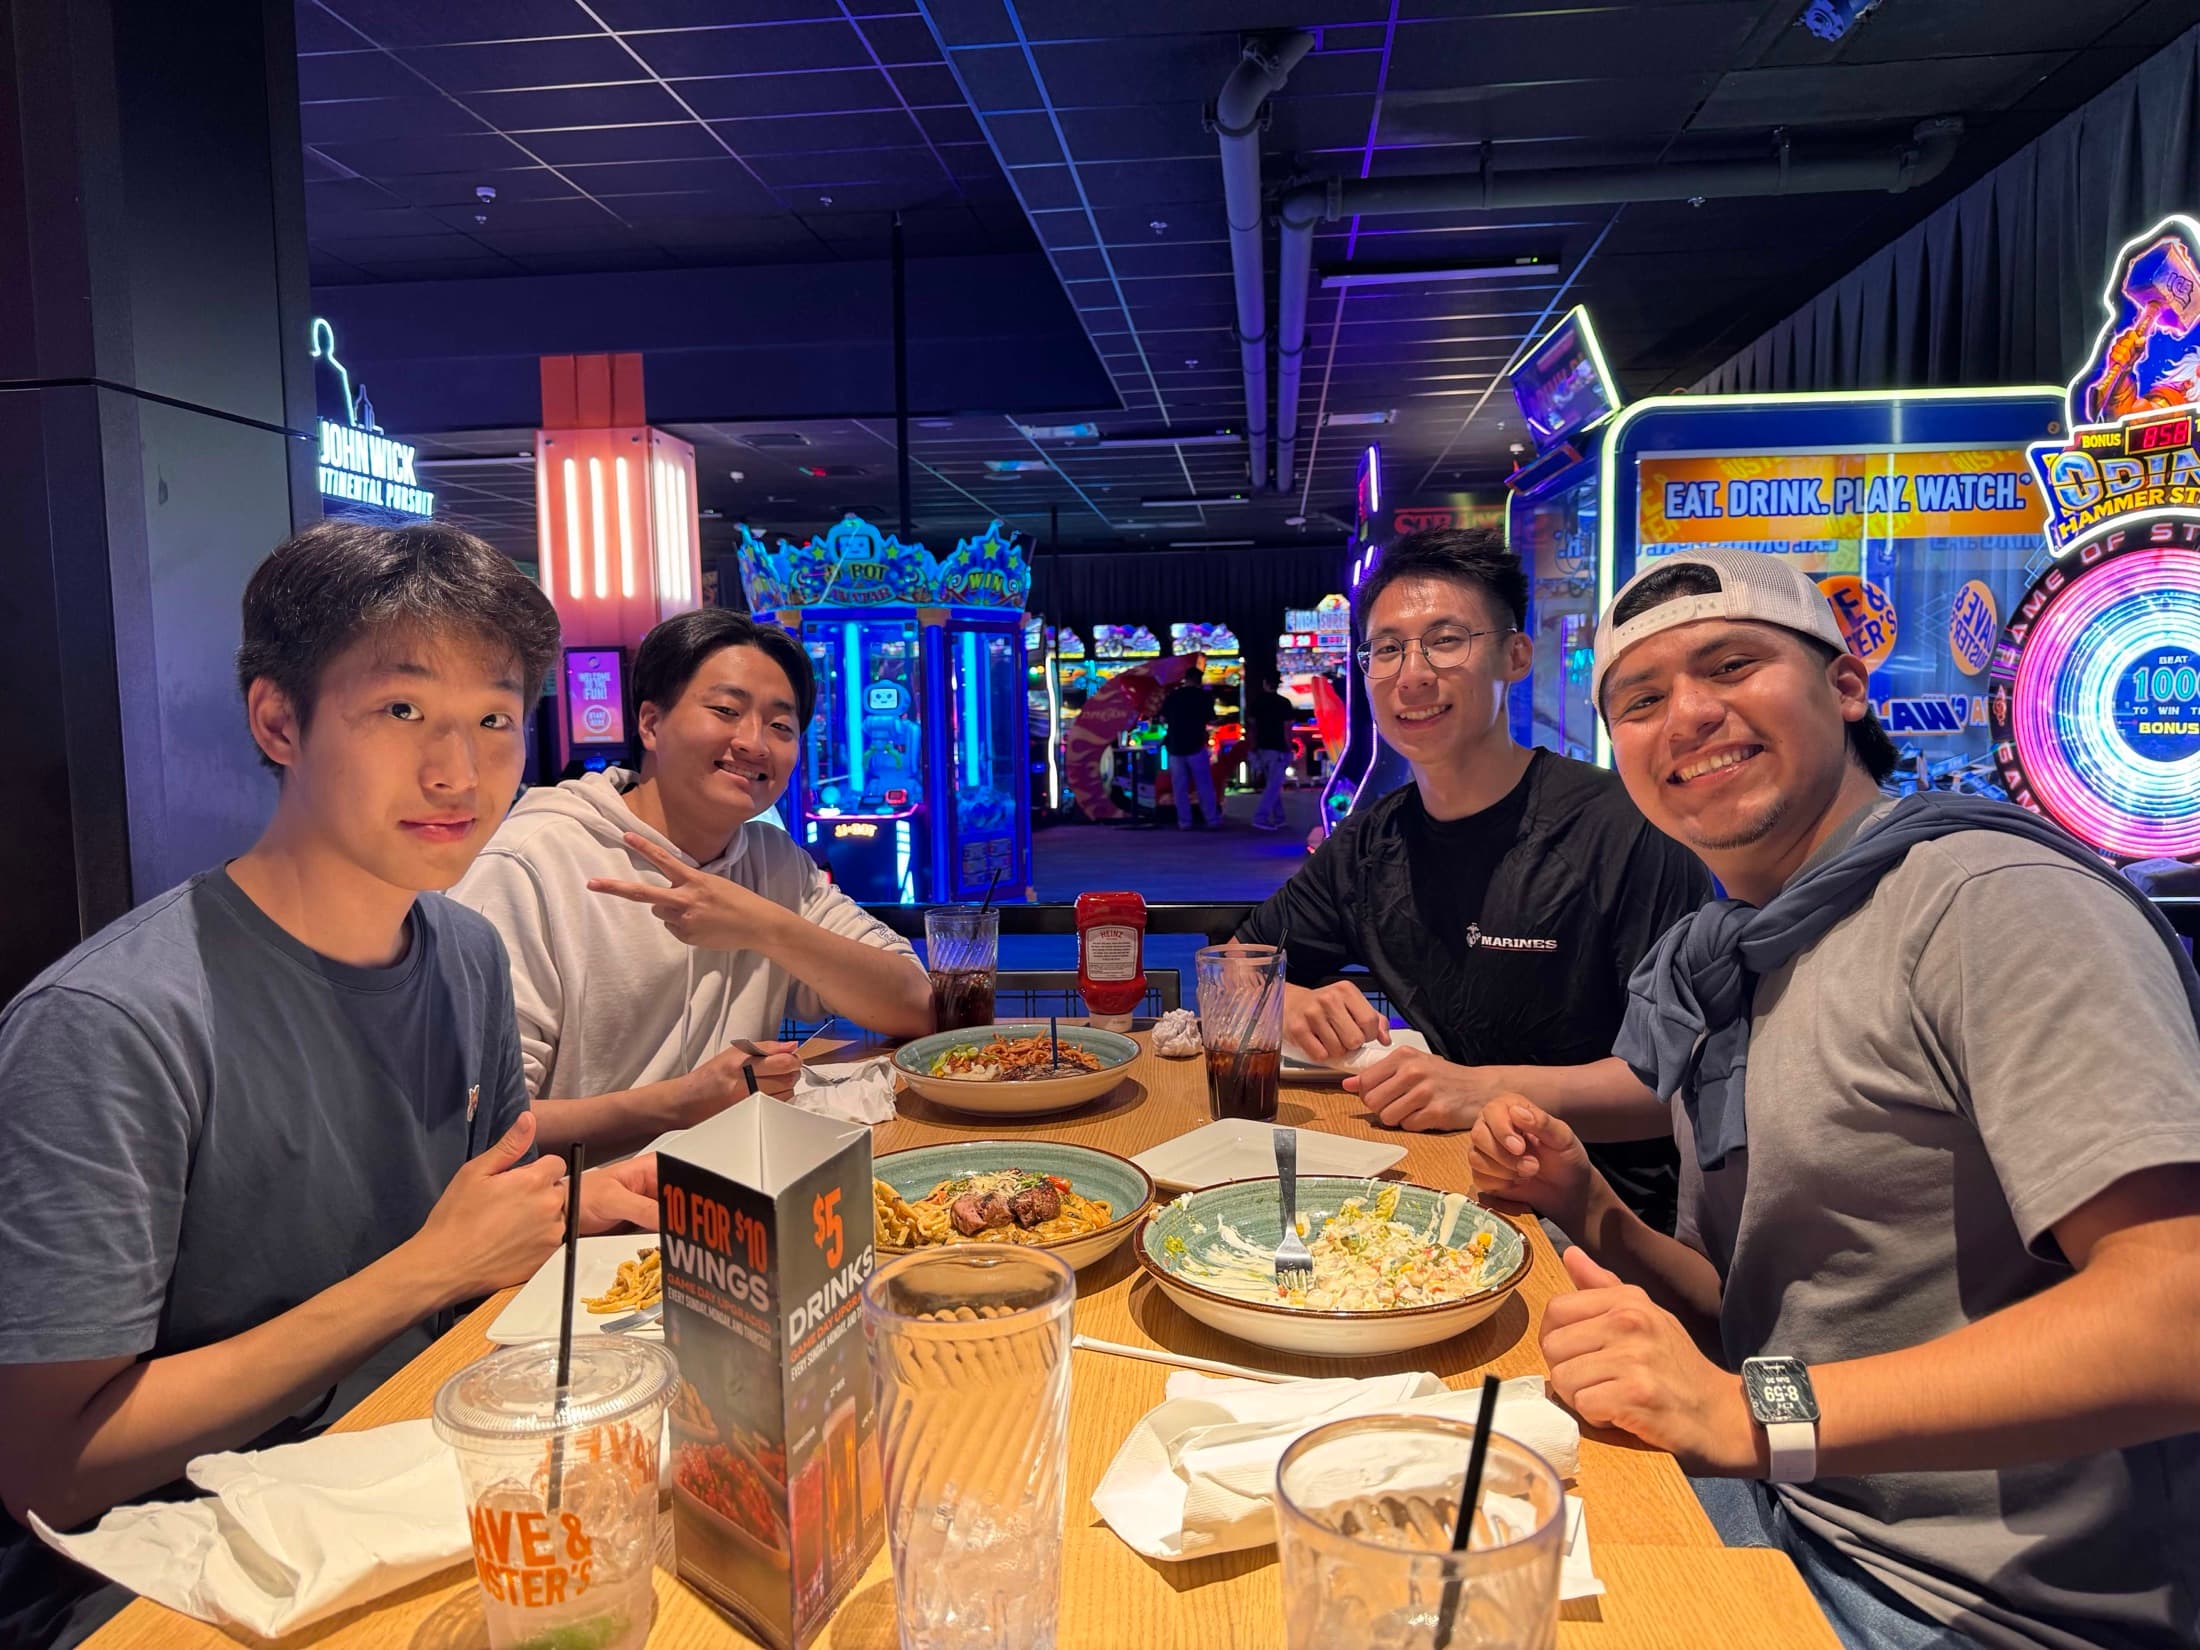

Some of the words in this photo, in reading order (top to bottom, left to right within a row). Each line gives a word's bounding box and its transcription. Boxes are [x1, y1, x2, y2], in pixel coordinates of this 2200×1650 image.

[320, 420, 369, 475] JOHN
[369, 434, 417, 486] WICK
[2082, 434, 2121, 448] BONUS
[1665, 481, 1722, 518] EAT.
[1728, 478, 1830, 517] DRINK.
[1833, 474, 1912, 515] PLAY.
[2058, 488, 2165, 539] HAMMER
[2080, 531, 2126, 565] OF
[968, 572, 1003, 592] WIN
[2159, 656, 2188, 664] BEAT
[2133, 707, 2148, 715] TO
[2158, 707, 2179, 715] WIN
[2139, 722, 2200, 734] BONUS
[1100, 929, 1125, 939] HEINZ
[1481, 936, 1558, 949] MARINES
[664, 1184, 687, 1236] 10
[691, 1193, 732, 1256] FOR
[735, 1208, 768, 1274] $10
[813, 1186, 843, 1269] $5
[666, 1233, 770, 1312] WINGS
[667, 1273, 696, 1293] GAME
[698, 1283, 716, 1303] DAY
[789, 1244, 873, 1346] DRINKS
[790, 1334, 817, 1363] GAME
[817, 1316, 834, 1339] DAY
[791, 1359, 807, 1382] EVERY
[1763, 1385, 1799, 1402] 8:59
[560, 1512, 592, 1560] &
